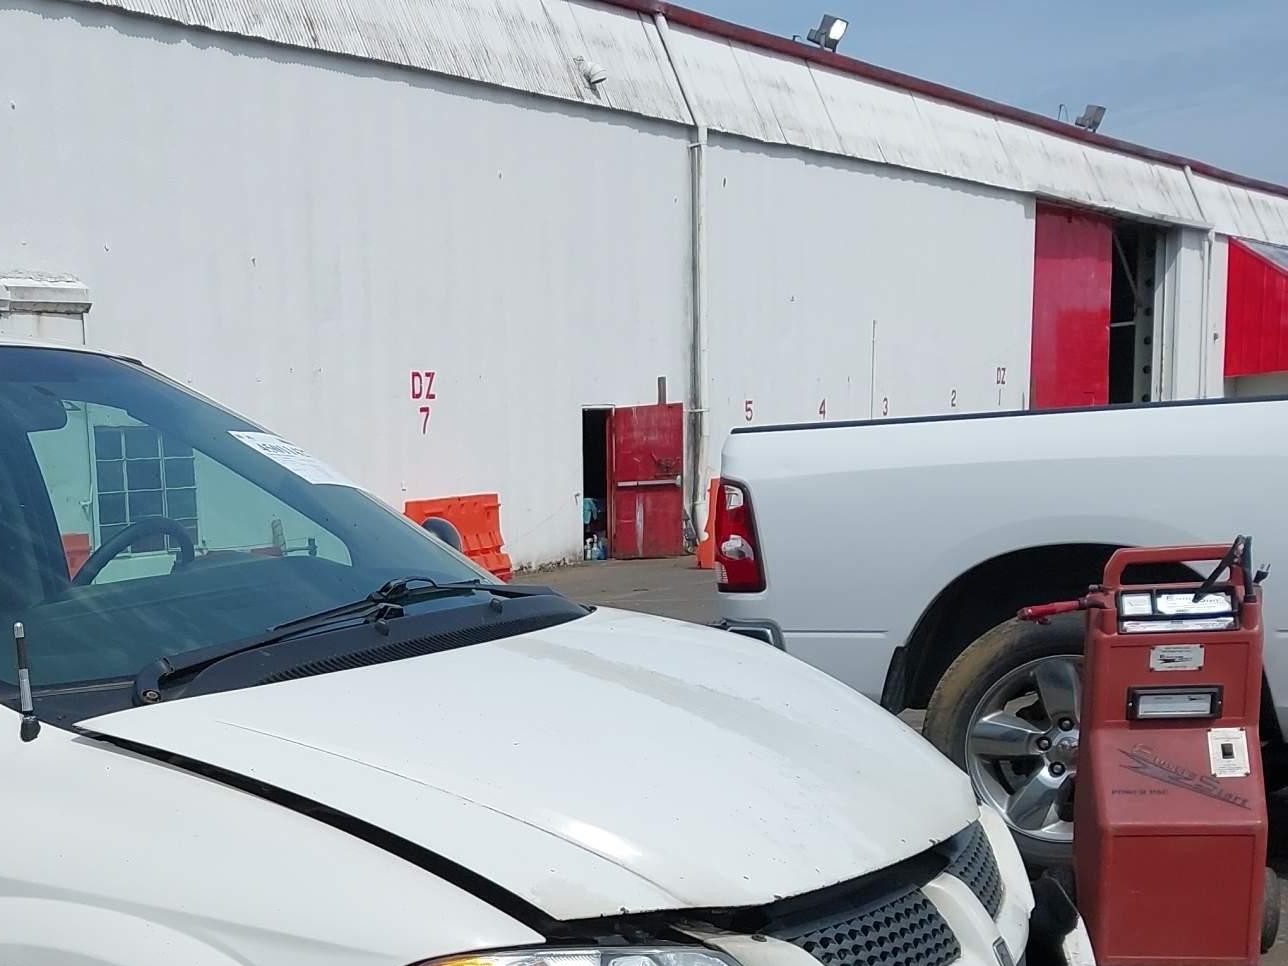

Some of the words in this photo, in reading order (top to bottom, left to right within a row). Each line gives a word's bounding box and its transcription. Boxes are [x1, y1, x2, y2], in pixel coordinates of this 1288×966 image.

[411, 371, 436, 400] DZ
[996, 367, 1006, 385] DZ
[818, 398, 826, 420] 4
[882, 397, 888, 416] 3
[951, 389, 957, 408] 2
[419, 406, 430, 435] 7
[745, 399, 753, 421] 5
